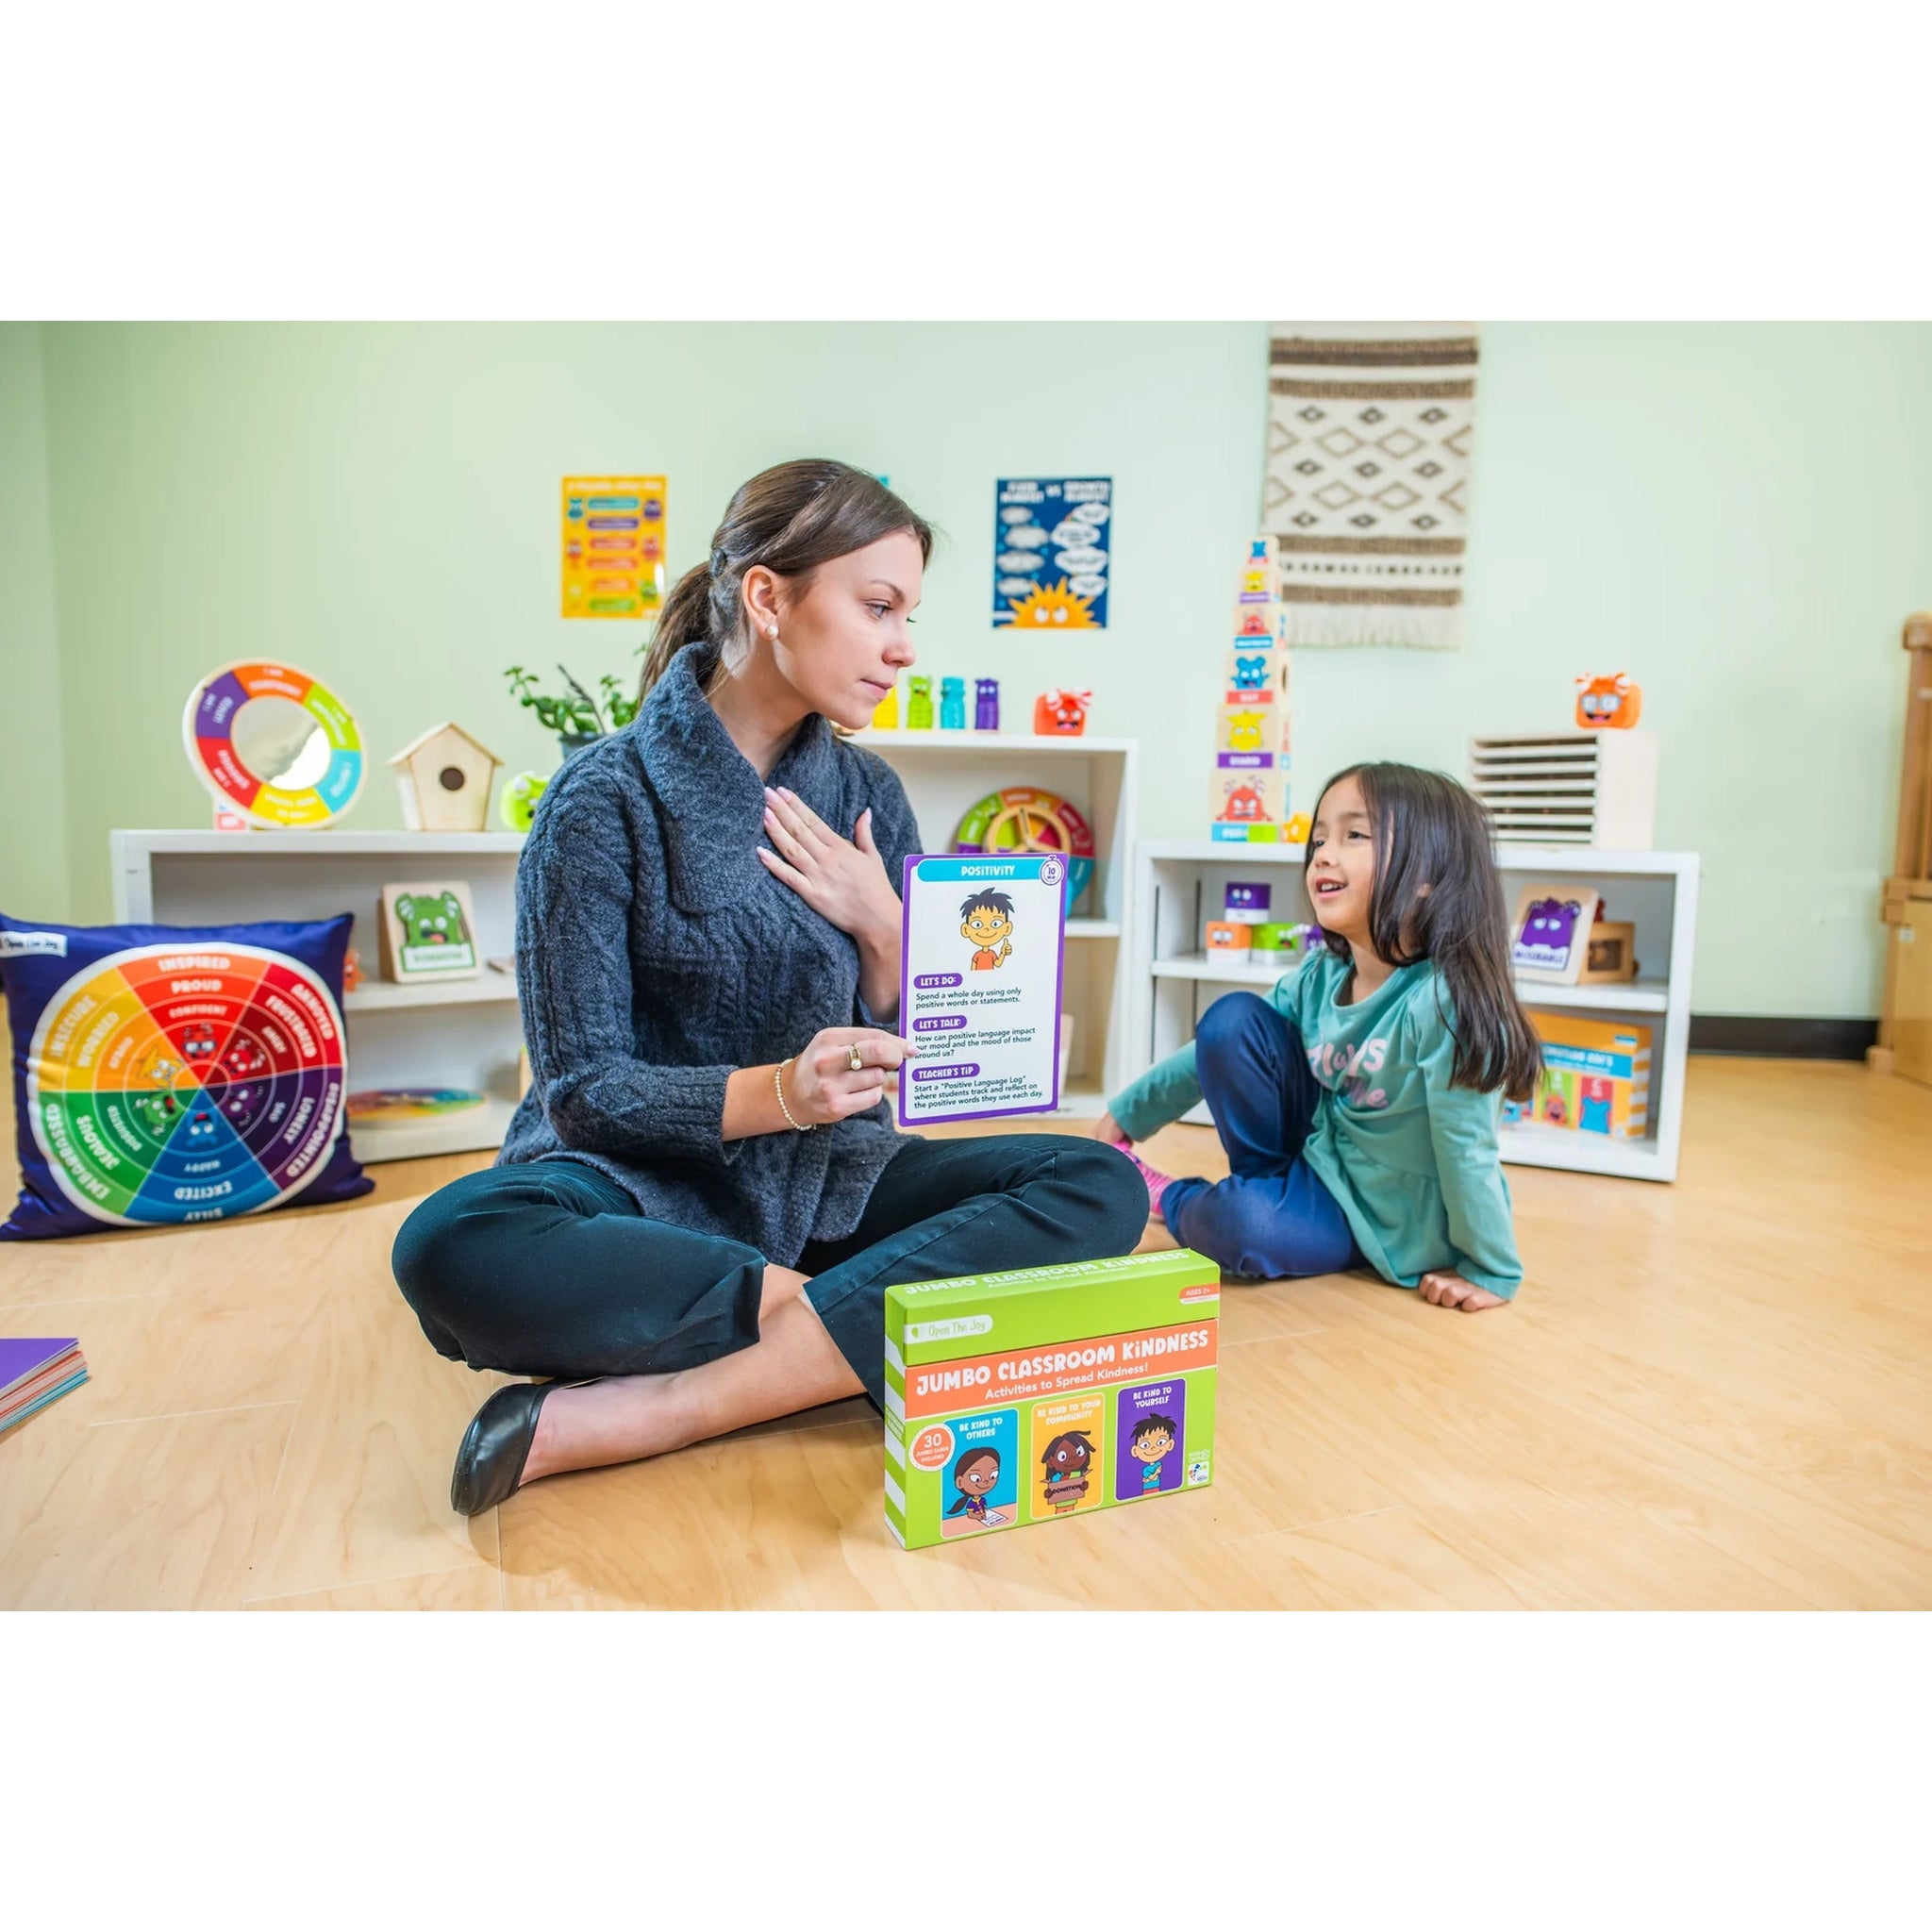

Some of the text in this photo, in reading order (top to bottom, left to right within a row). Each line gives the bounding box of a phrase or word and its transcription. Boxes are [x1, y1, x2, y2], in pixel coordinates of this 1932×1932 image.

[158, 955, 231, 973] INSPIRED
[171, 978, 223, 994] PROUD
[920, 976, 957, 986] LET'S DO:
[916, 992, 940, 1001] Spend
[1007, 987, 1022, 995] only
[916, 1000, 944, 1010] positive
[980, 996, 1020, 1005] statements.
[290, 983, 333, 1041] ANNOYED
[919, 1018, 961, 1029] LET'S TALK:
[948, 1032, 976, 1041] positive
[918, 1068, 958, 1079] TEACHER'S
[974, 1078, 1008, 1087] Language
[914, 1092, 937, 1101] where
[939, 1090, 969, 1098] students
[971, 1087, 988, 1095] track
[990, 1085, 1004, 1093] and
[914, 1101, 927, 1109] the
[927, 1098, 957, 1108] positive
[981, 1094, 997, 1103] they
[75, 1114, 121, 1172] JEALOUS
[44, 1102, 111, 1202] EMBARRASSED
[175, 1180, 233, 1201] EXCITED
[904, 1278, 977, 1294] JUMBO
[982, 1264, 1099, 1283] CLASSROOM
[928, 1320, 986, 1338] Open The Joy
[916, 1366, 991, 1396] JUMBO
[997, 1344, 1115, 1381] CLASSROOM
[985, 1362, 1149, 1400] Activities to Spread Kindness!
[1133, 1391, 1141, 1400] BE
[1162, 1386, 1173, 1395] TO
[1037, 1399, 1101, 1418] BE KIND TO YOUR
[1135, 1395, 1170, 1408] YOURSELF
[1045, 1410, 1093, 1424] COMMUNITY
[958, 1417, 1003, 1433] BE KIND TO
[924, 1433, 942, 1448] 30
[966, 1427, 996, 1441] OTHERS
